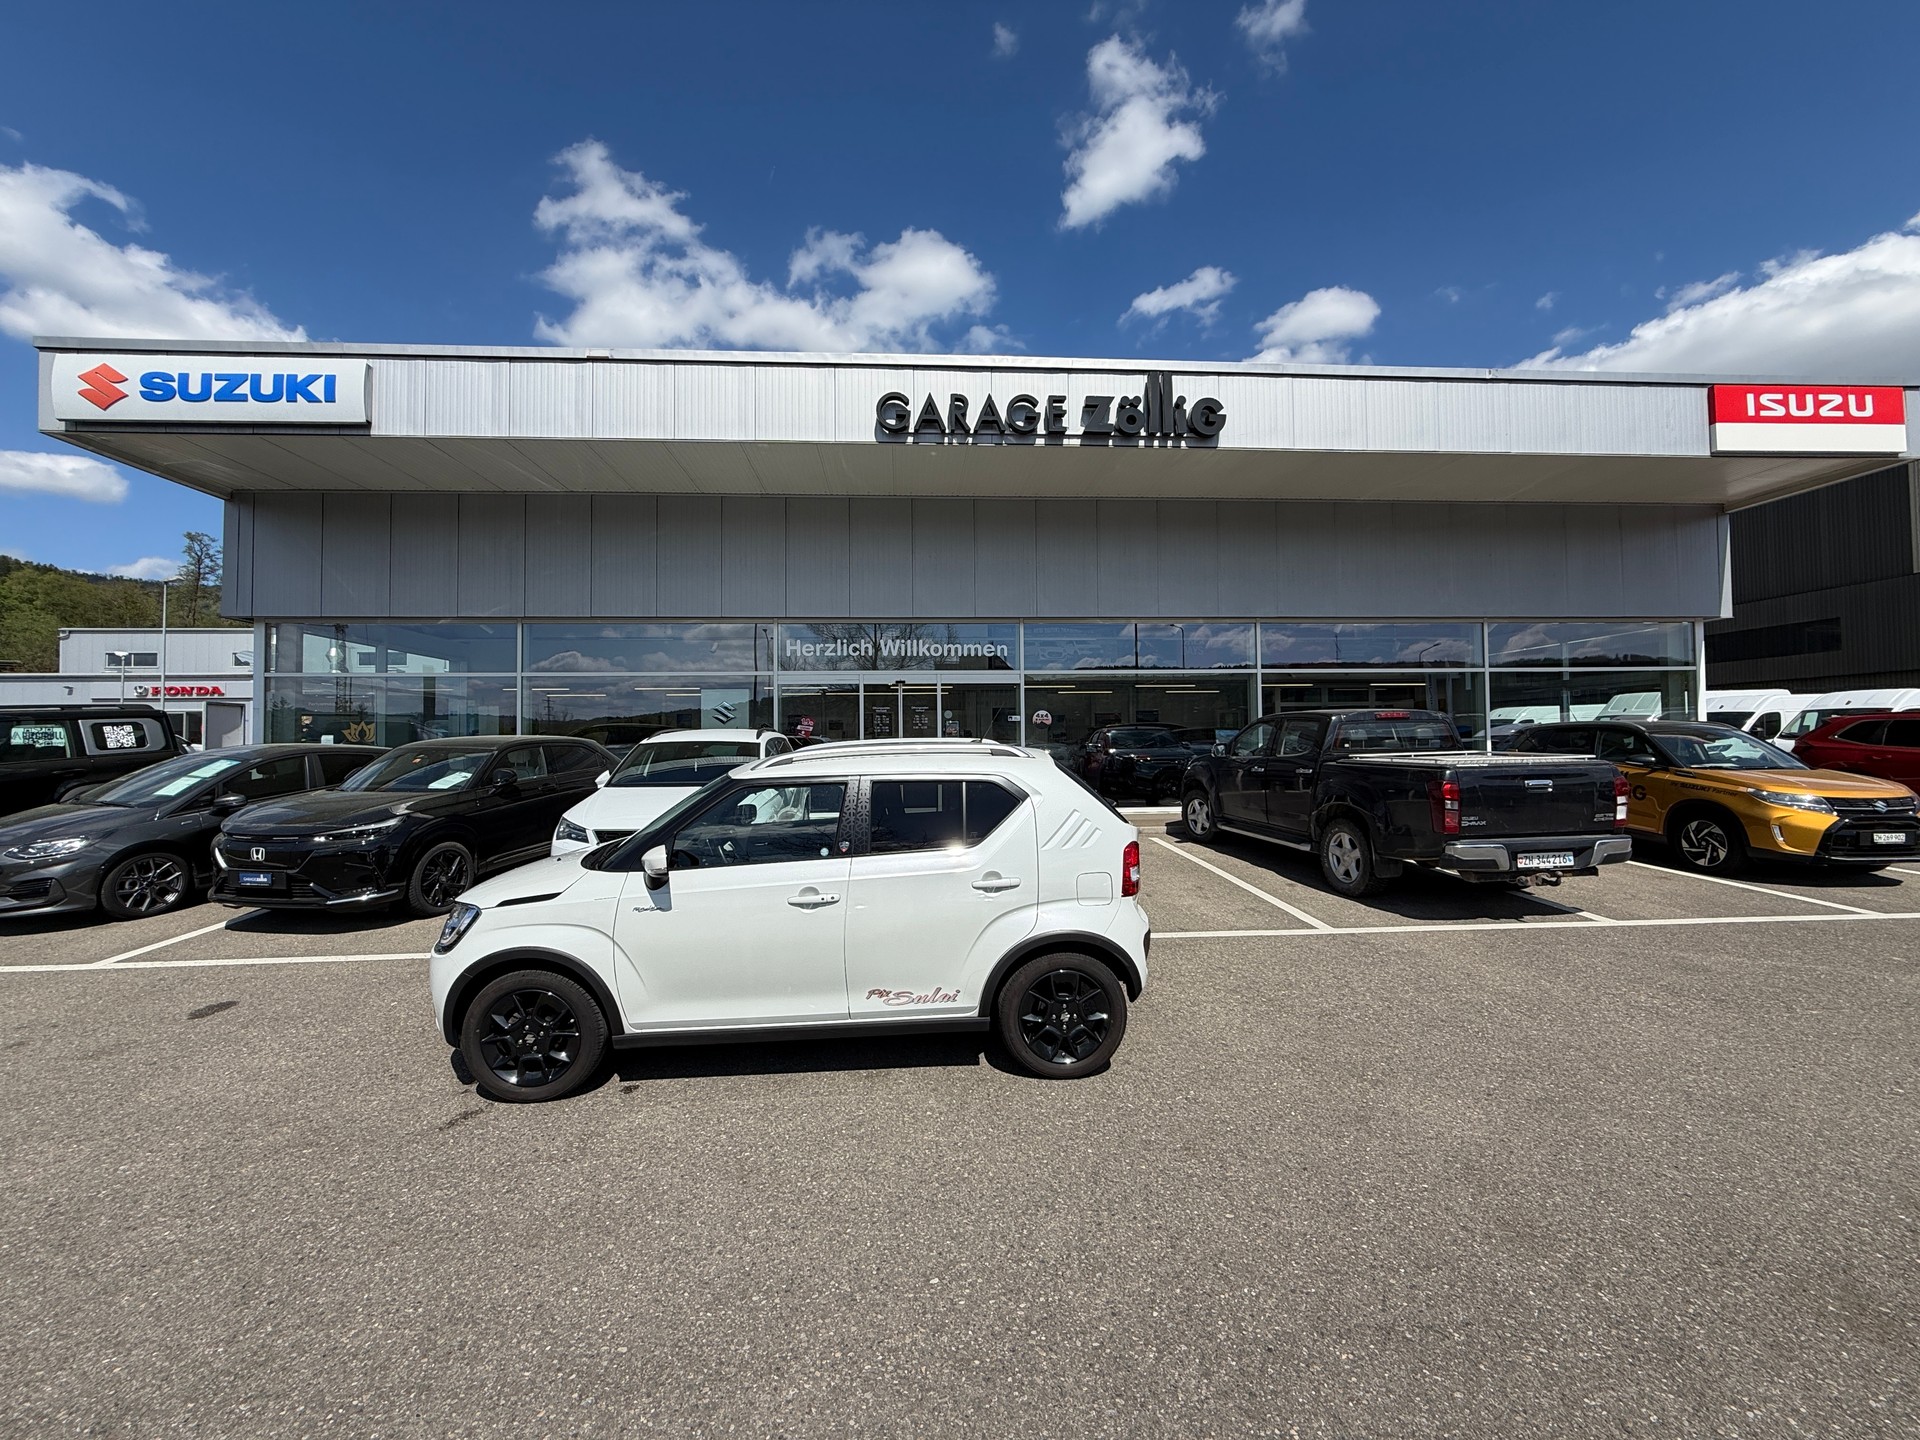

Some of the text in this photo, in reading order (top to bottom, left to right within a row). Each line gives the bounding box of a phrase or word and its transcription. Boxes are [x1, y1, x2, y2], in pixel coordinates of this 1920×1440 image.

[139, 372, 336, 403] SUZUKI
[875, 391, 1069, 434] GARAGE
[1746, 393, 1874, 418] ISUZU
[785, 639, 1008, 657] Herzlich Willkommen
[151, 686, 225, 697] HONDA
[1679, 782, 1710, 792] SUZUKI
